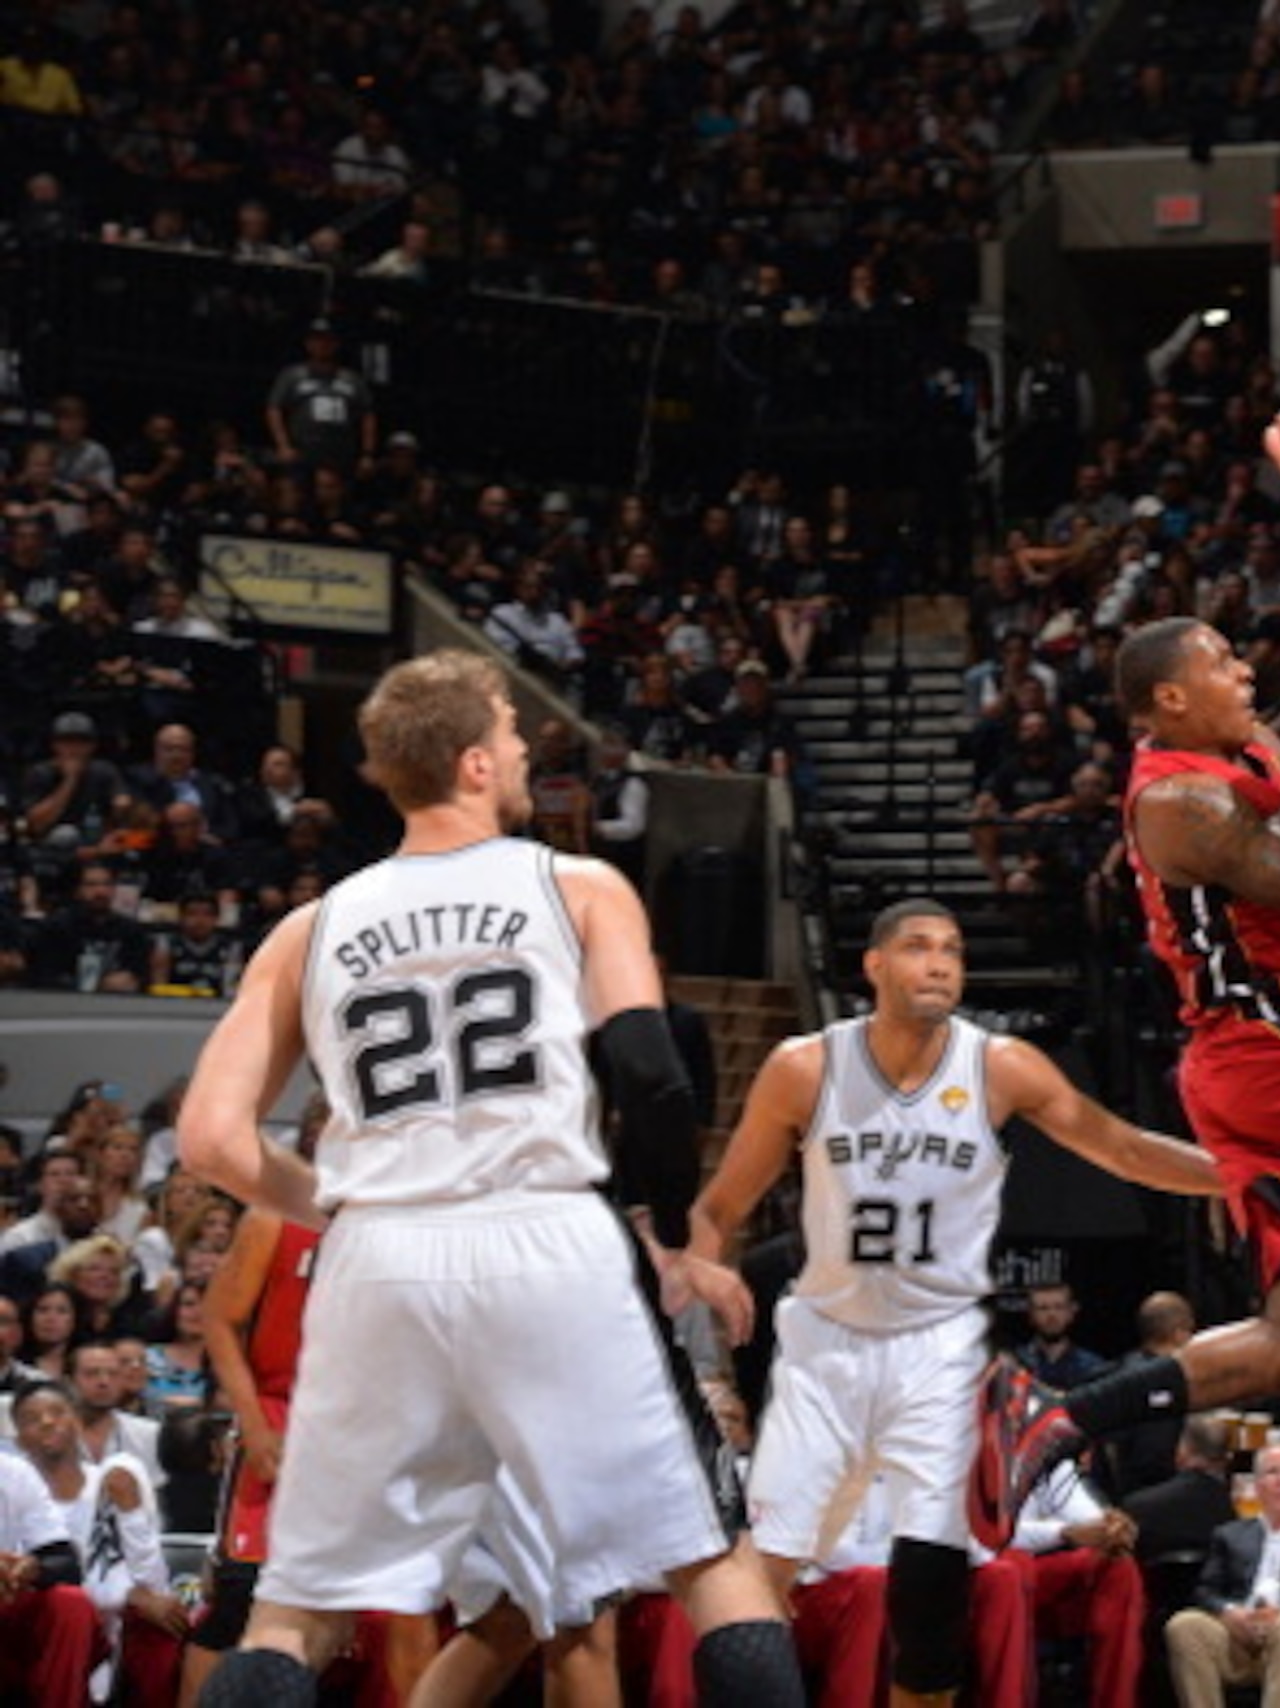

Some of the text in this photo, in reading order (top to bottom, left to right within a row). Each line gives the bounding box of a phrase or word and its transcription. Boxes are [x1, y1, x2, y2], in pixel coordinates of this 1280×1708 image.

[335, 904, 527, 978] SPLITTER
[343, 966, 541, 1120] 22
[826, 1131, 976, 1180] SPURS
[851, 1199, 935, 1263] 21
